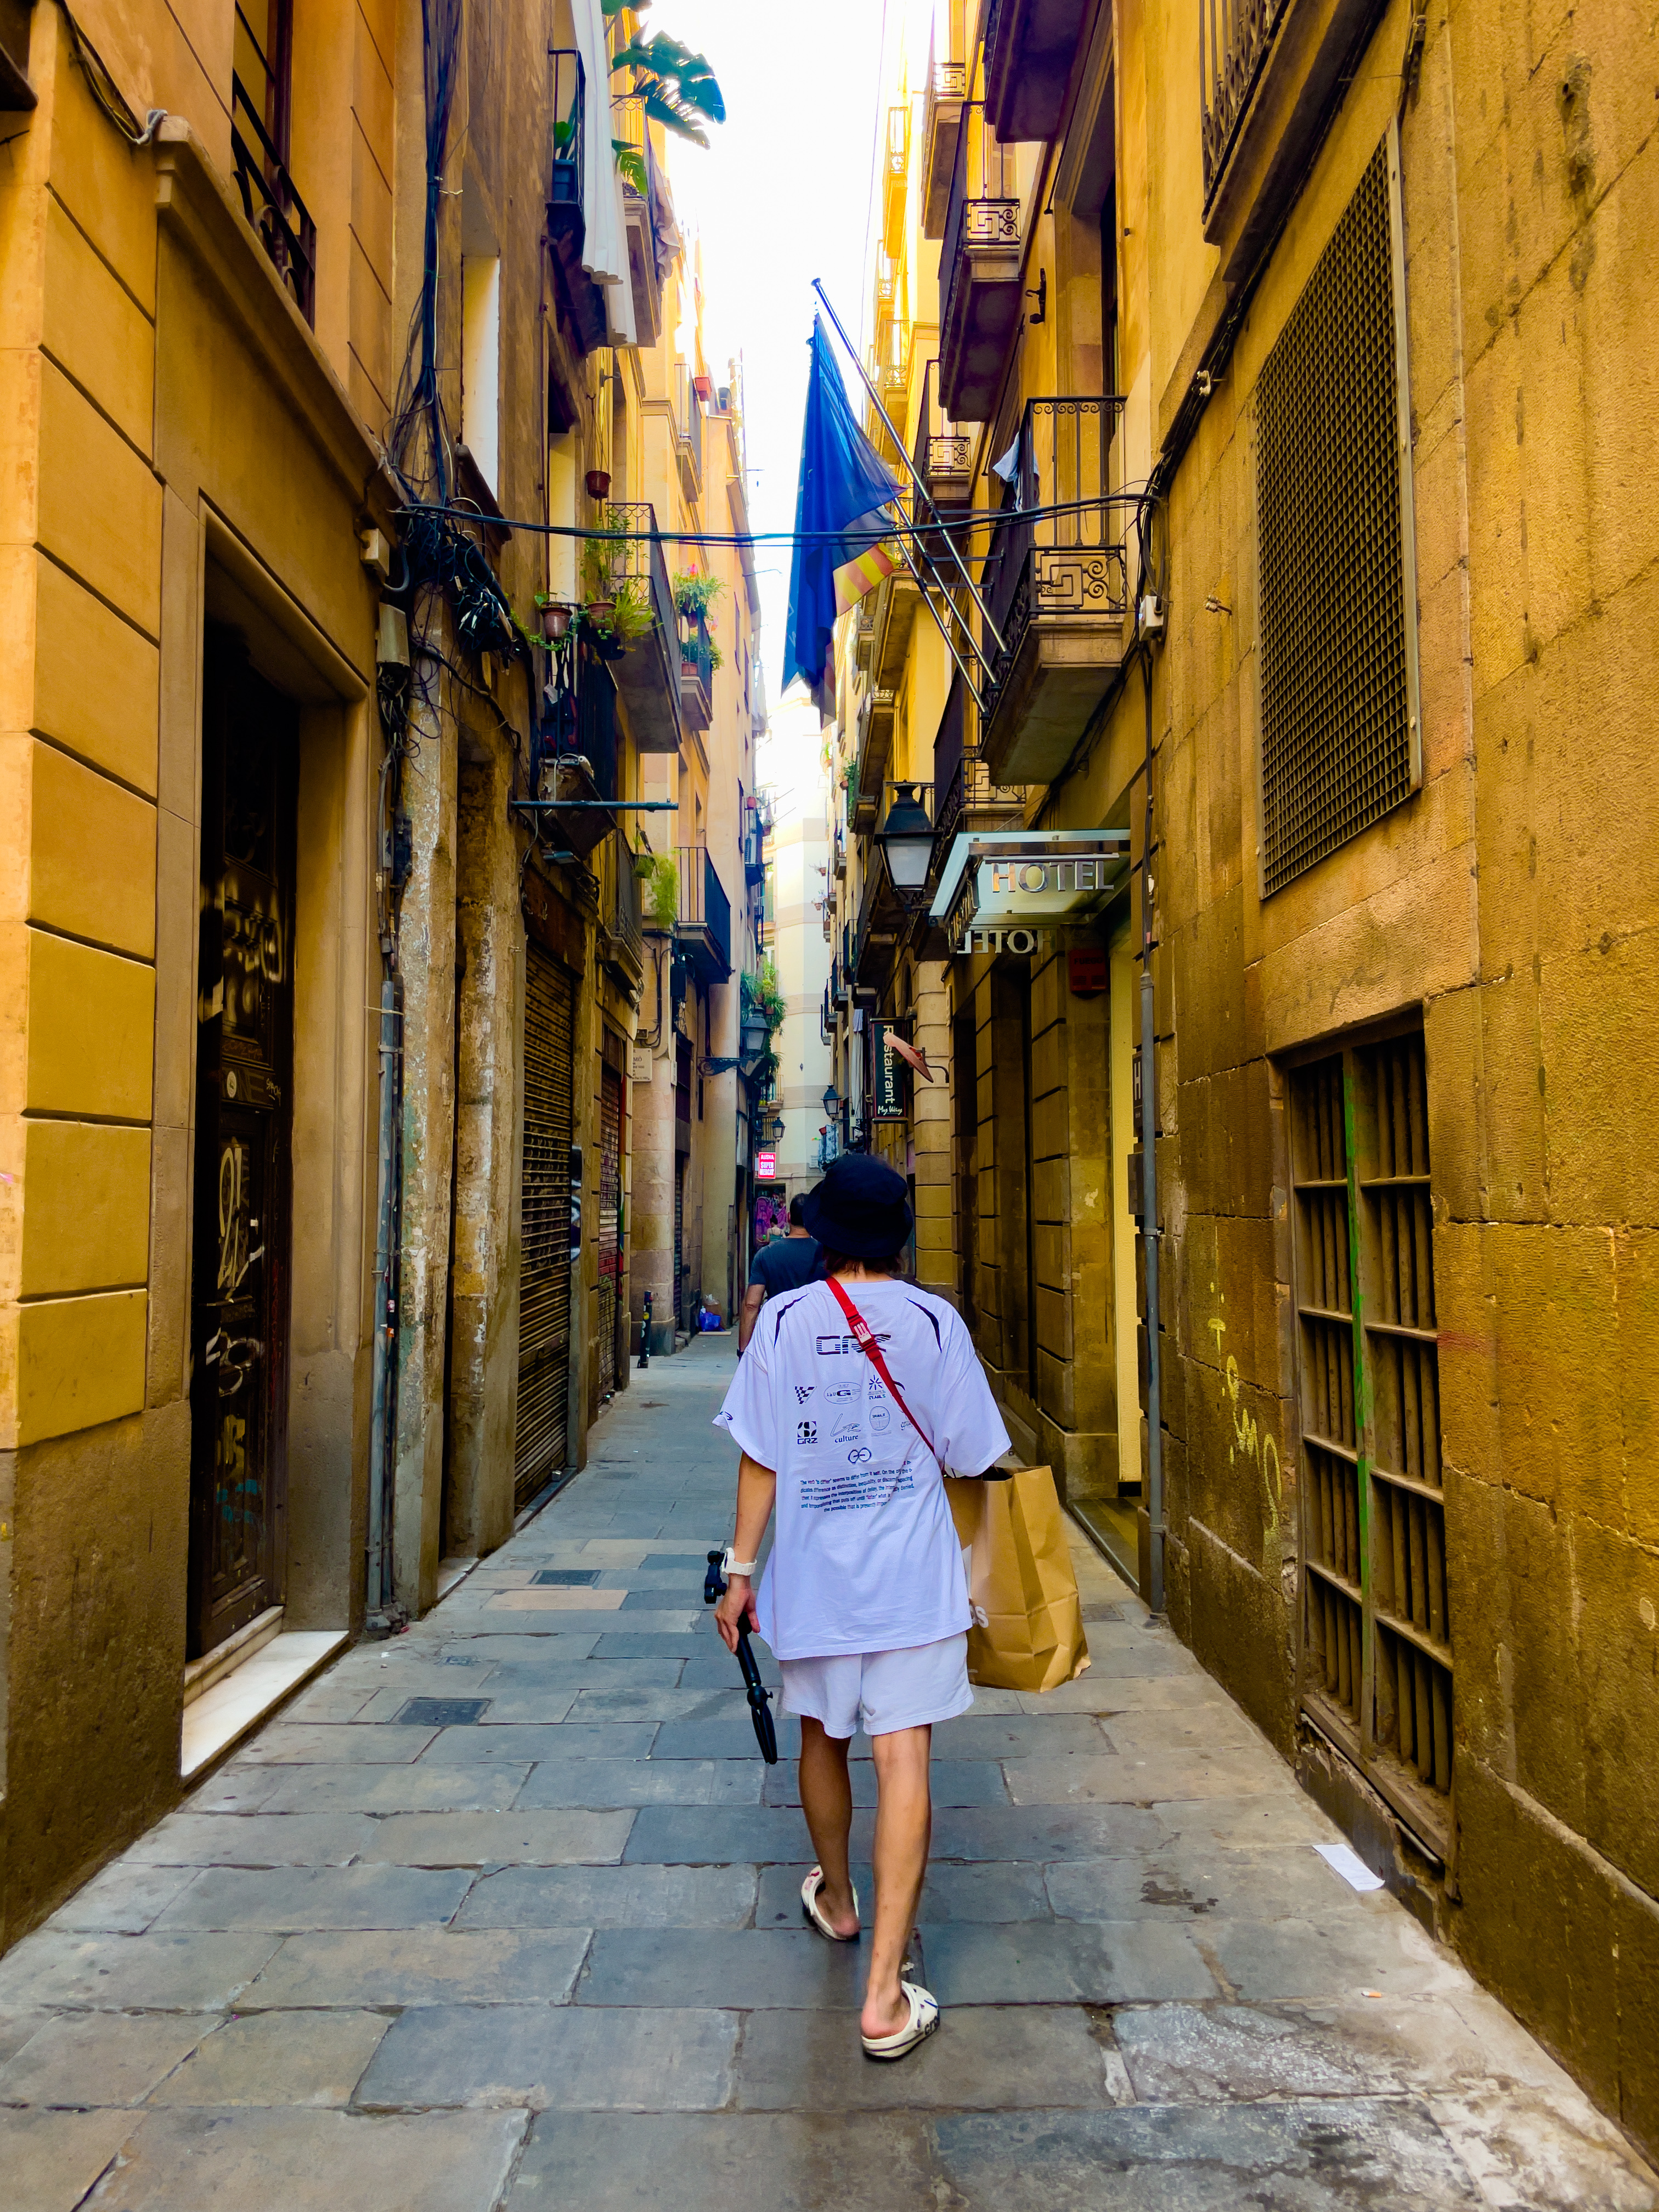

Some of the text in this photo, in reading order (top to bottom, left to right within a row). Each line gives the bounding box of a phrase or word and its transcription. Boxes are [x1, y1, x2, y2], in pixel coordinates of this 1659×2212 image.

[992, 861, 1114, 892] HOTEL
[883, 1025, 895, 1104] Rstaurant
[1134, 1060, 1141, 1101] H
[834, 1435, 859, 1443] culture
